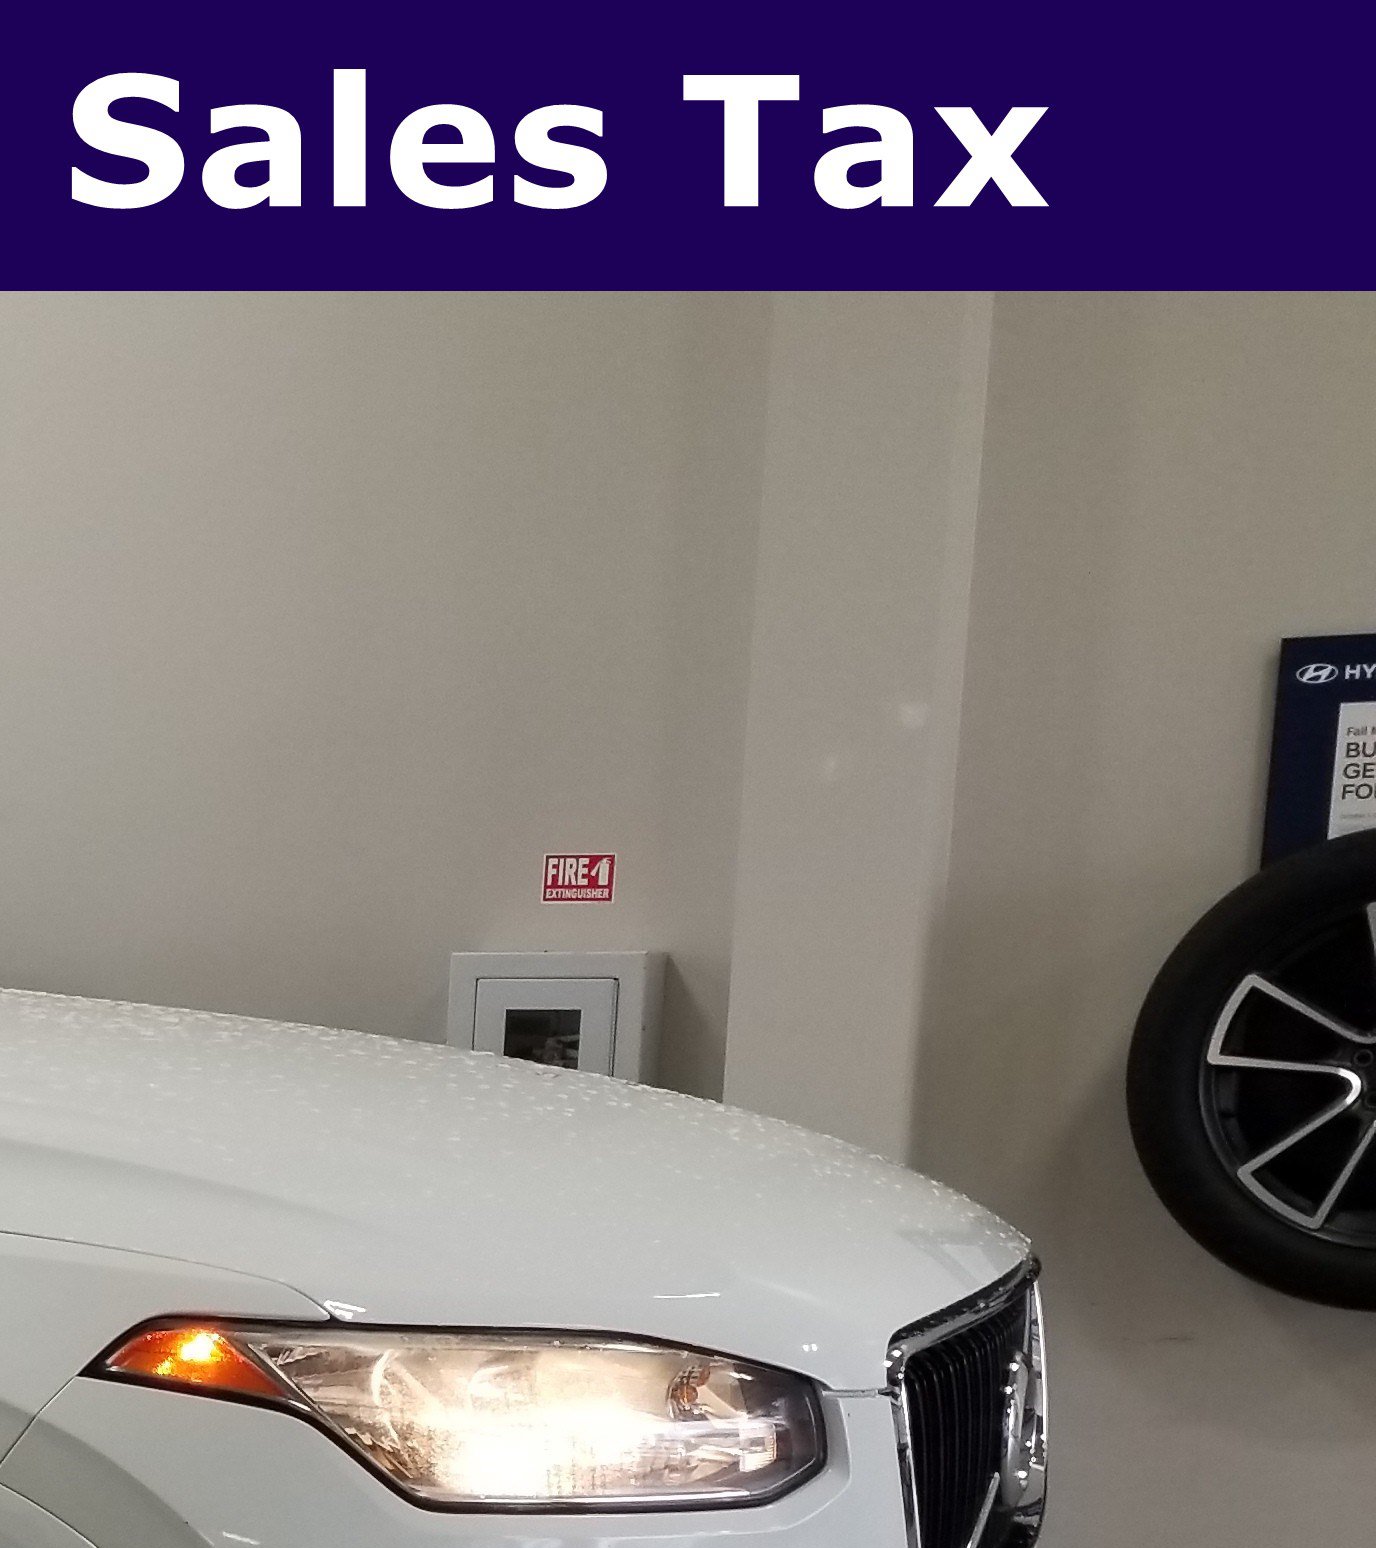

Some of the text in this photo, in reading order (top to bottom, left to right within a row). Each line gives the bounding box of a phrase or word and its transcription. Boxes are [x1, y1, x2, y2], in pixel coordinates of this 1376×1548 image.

[1341, 783, 1376, 800] FO
[547, 857, 590, 885] FIRE
[545, 888, 609, 899] EXTINGUISHER
